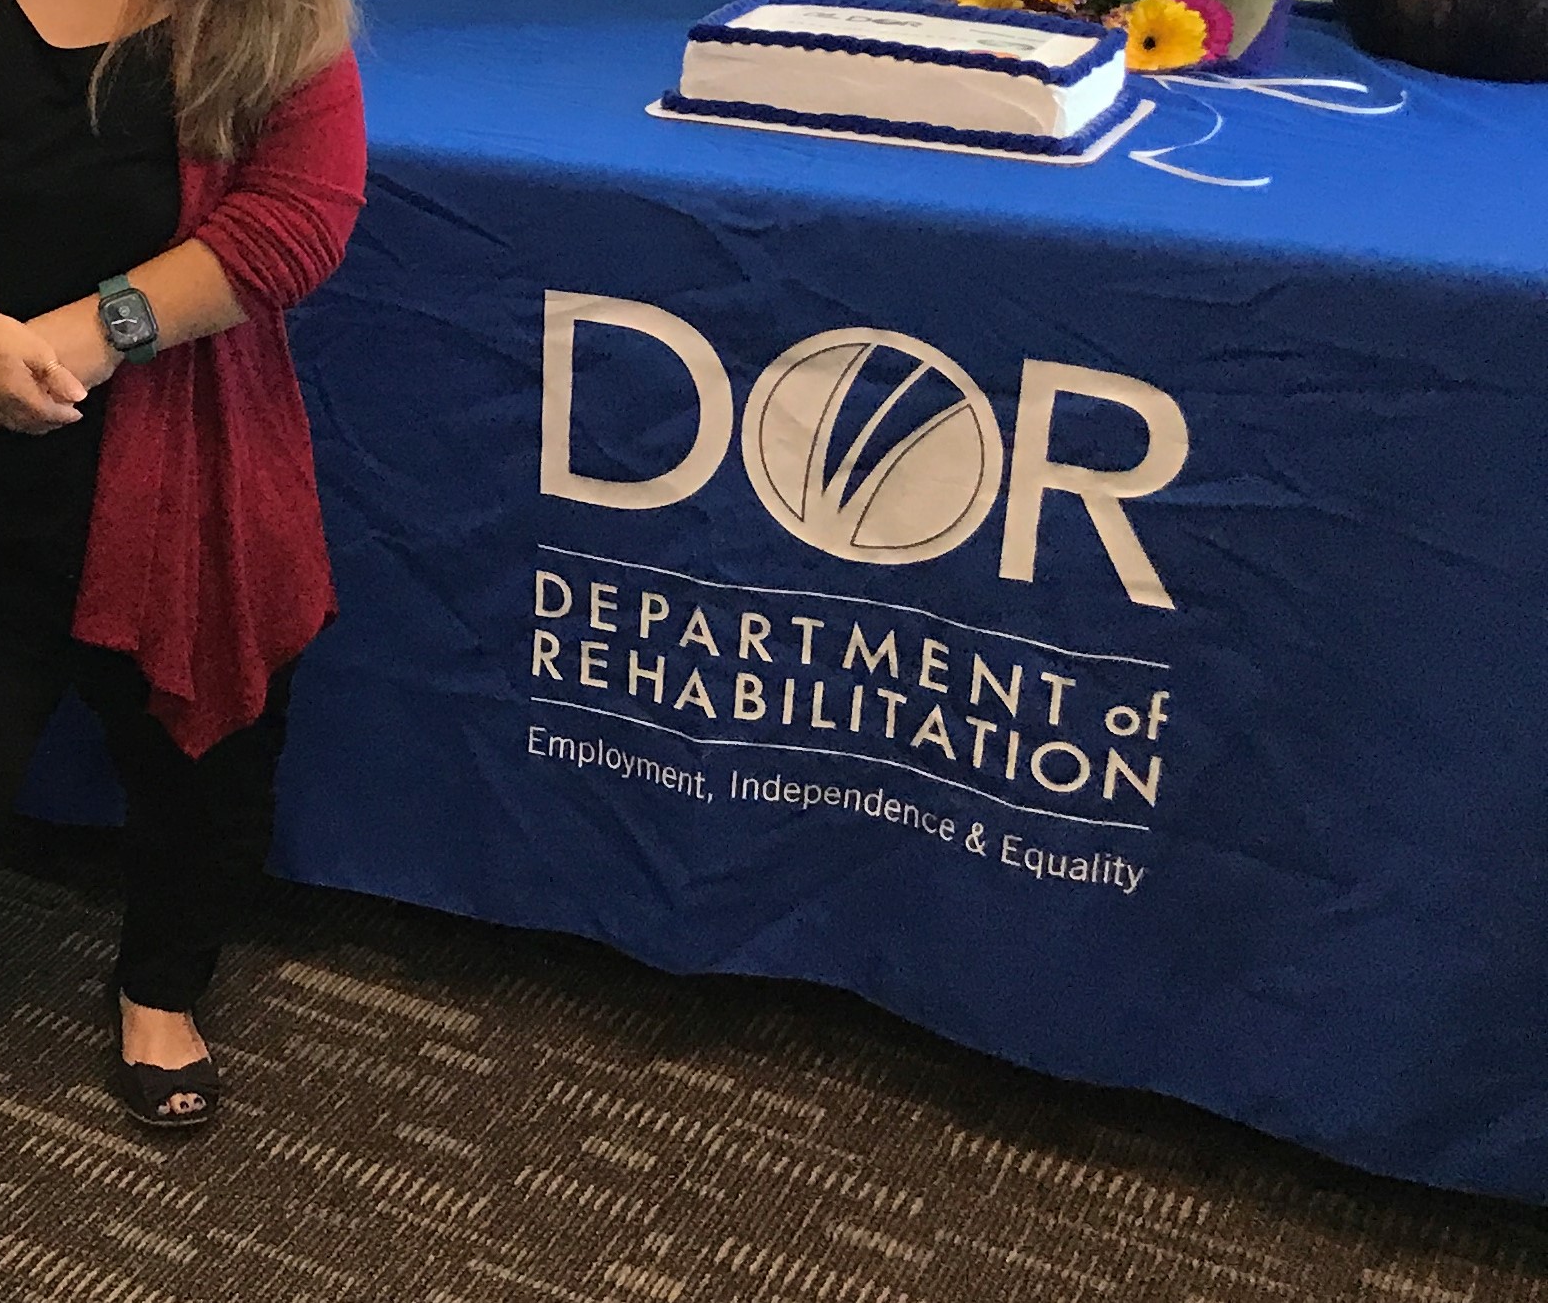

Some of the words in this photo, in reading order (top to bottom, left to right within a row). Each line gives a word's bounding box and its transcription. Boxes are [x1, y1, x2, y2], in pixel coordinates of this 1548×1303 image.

[539, 288, 1191, 611] DOR
[531, 629, 1162, 808] REHABILITATION
[535, 570, 1077, 726] DEPARTMENT
[1105, 690, 1170, 740] of
[527, 725, 714, 804] Employment,
[731, 770, 955, 842] Independence
[964, 822, 987, 857] &
[1001, 834, 1146, 895] Equality
